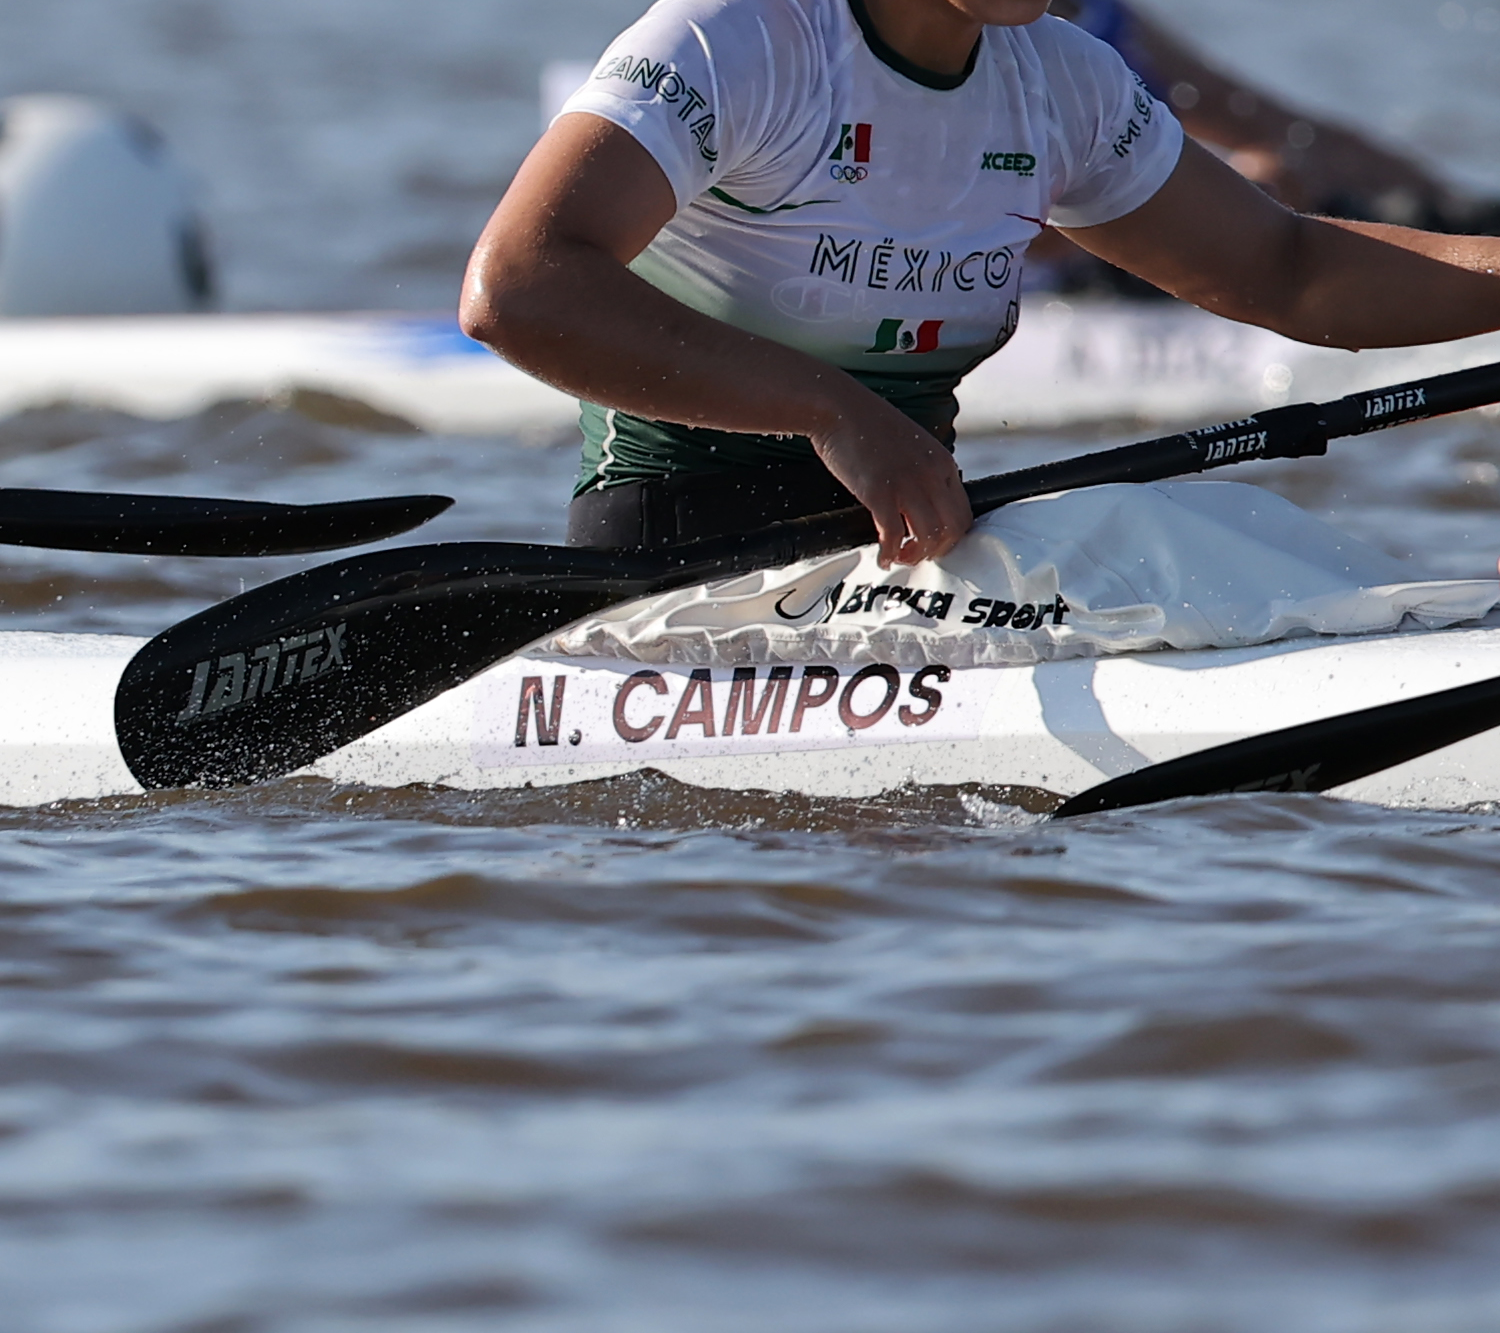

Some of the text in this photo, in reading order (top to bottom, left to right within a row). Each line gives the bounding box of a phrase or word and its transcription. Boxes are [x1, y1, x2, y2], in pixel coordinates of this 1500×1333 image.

[980, 151, 1036, 172] XCEED
[514, 663, 951, 748] N. CAMPOS
